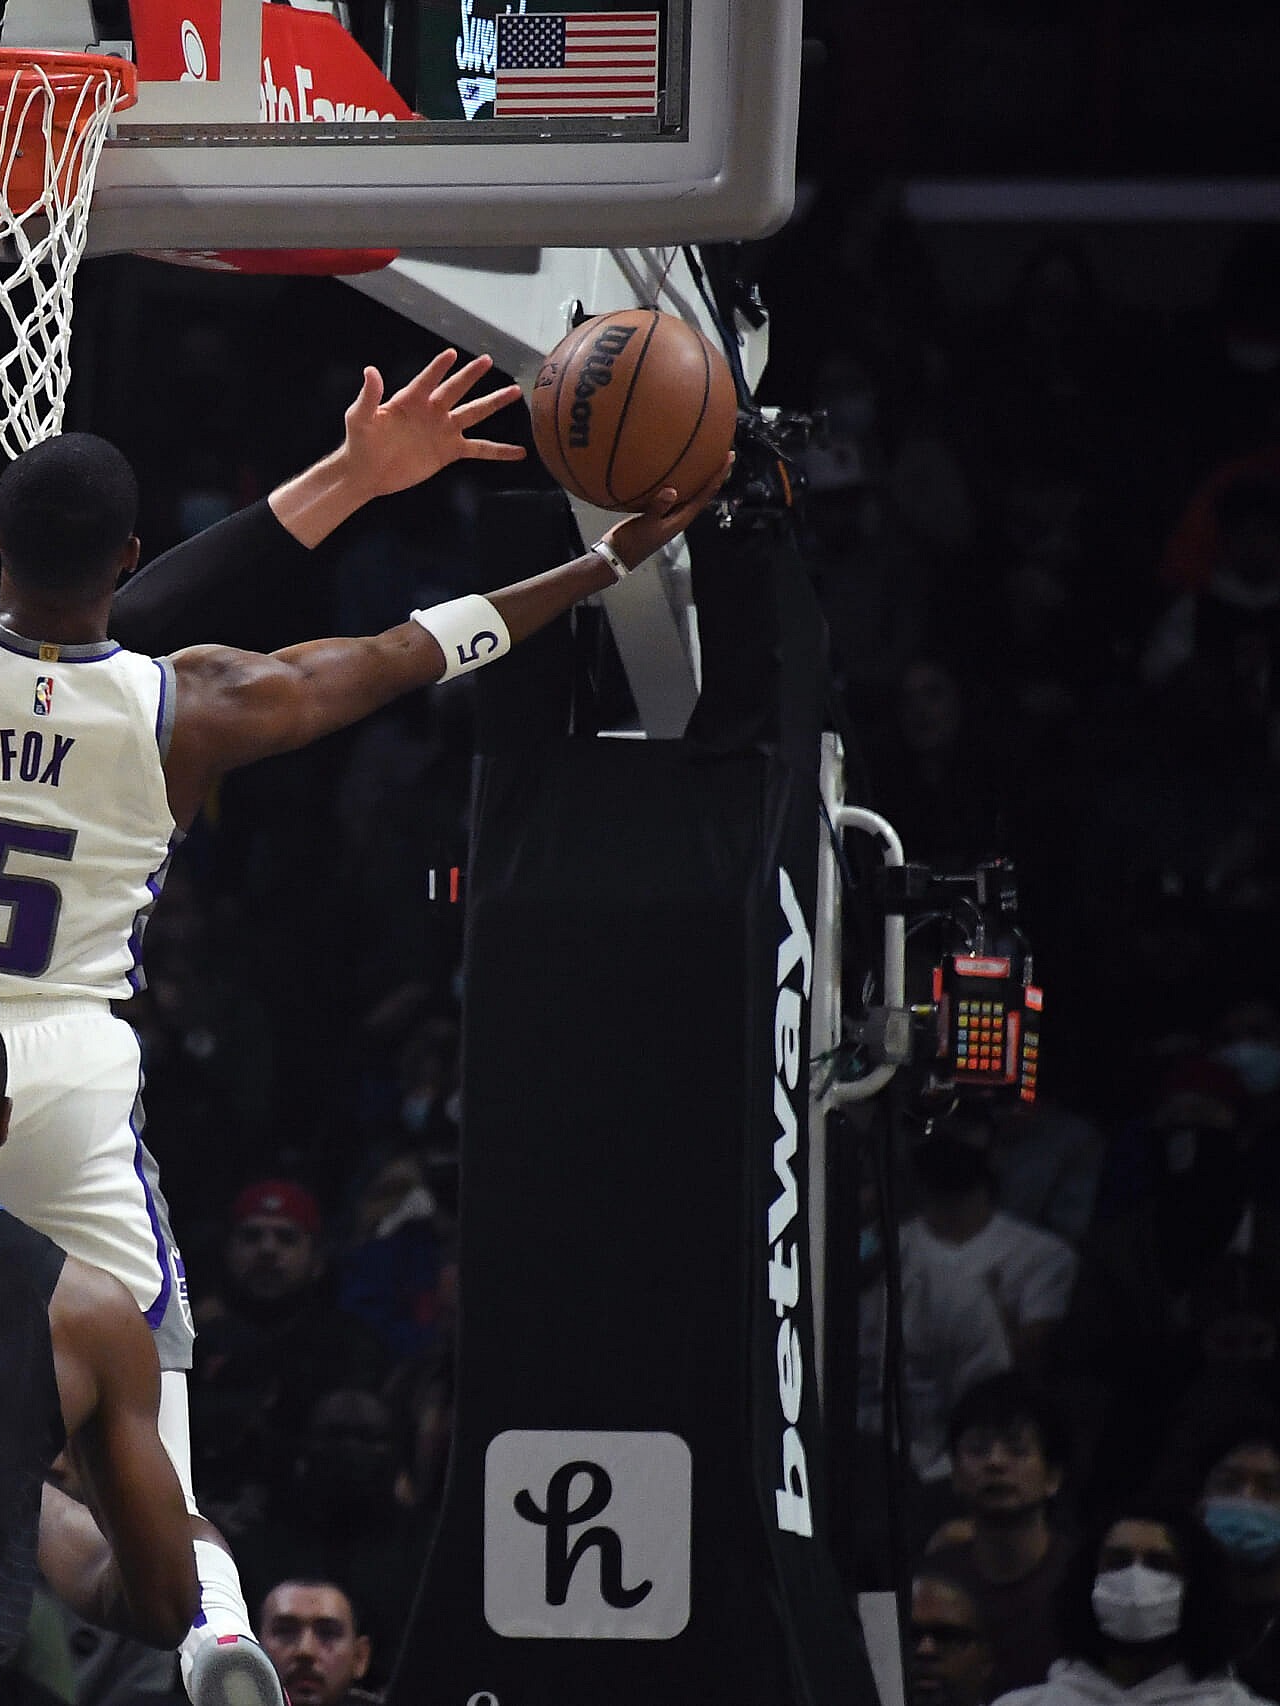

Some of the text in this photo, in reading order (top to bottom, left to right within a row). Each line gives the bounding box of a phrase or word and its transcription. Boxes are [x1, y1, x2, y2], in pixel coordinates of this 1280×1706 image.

[570, 325, 638, 448] Wilson
[456, 630, 498, 665] 5
[0, 728, 76, 788] FOX
[768, 865, 813, 1538] betway
